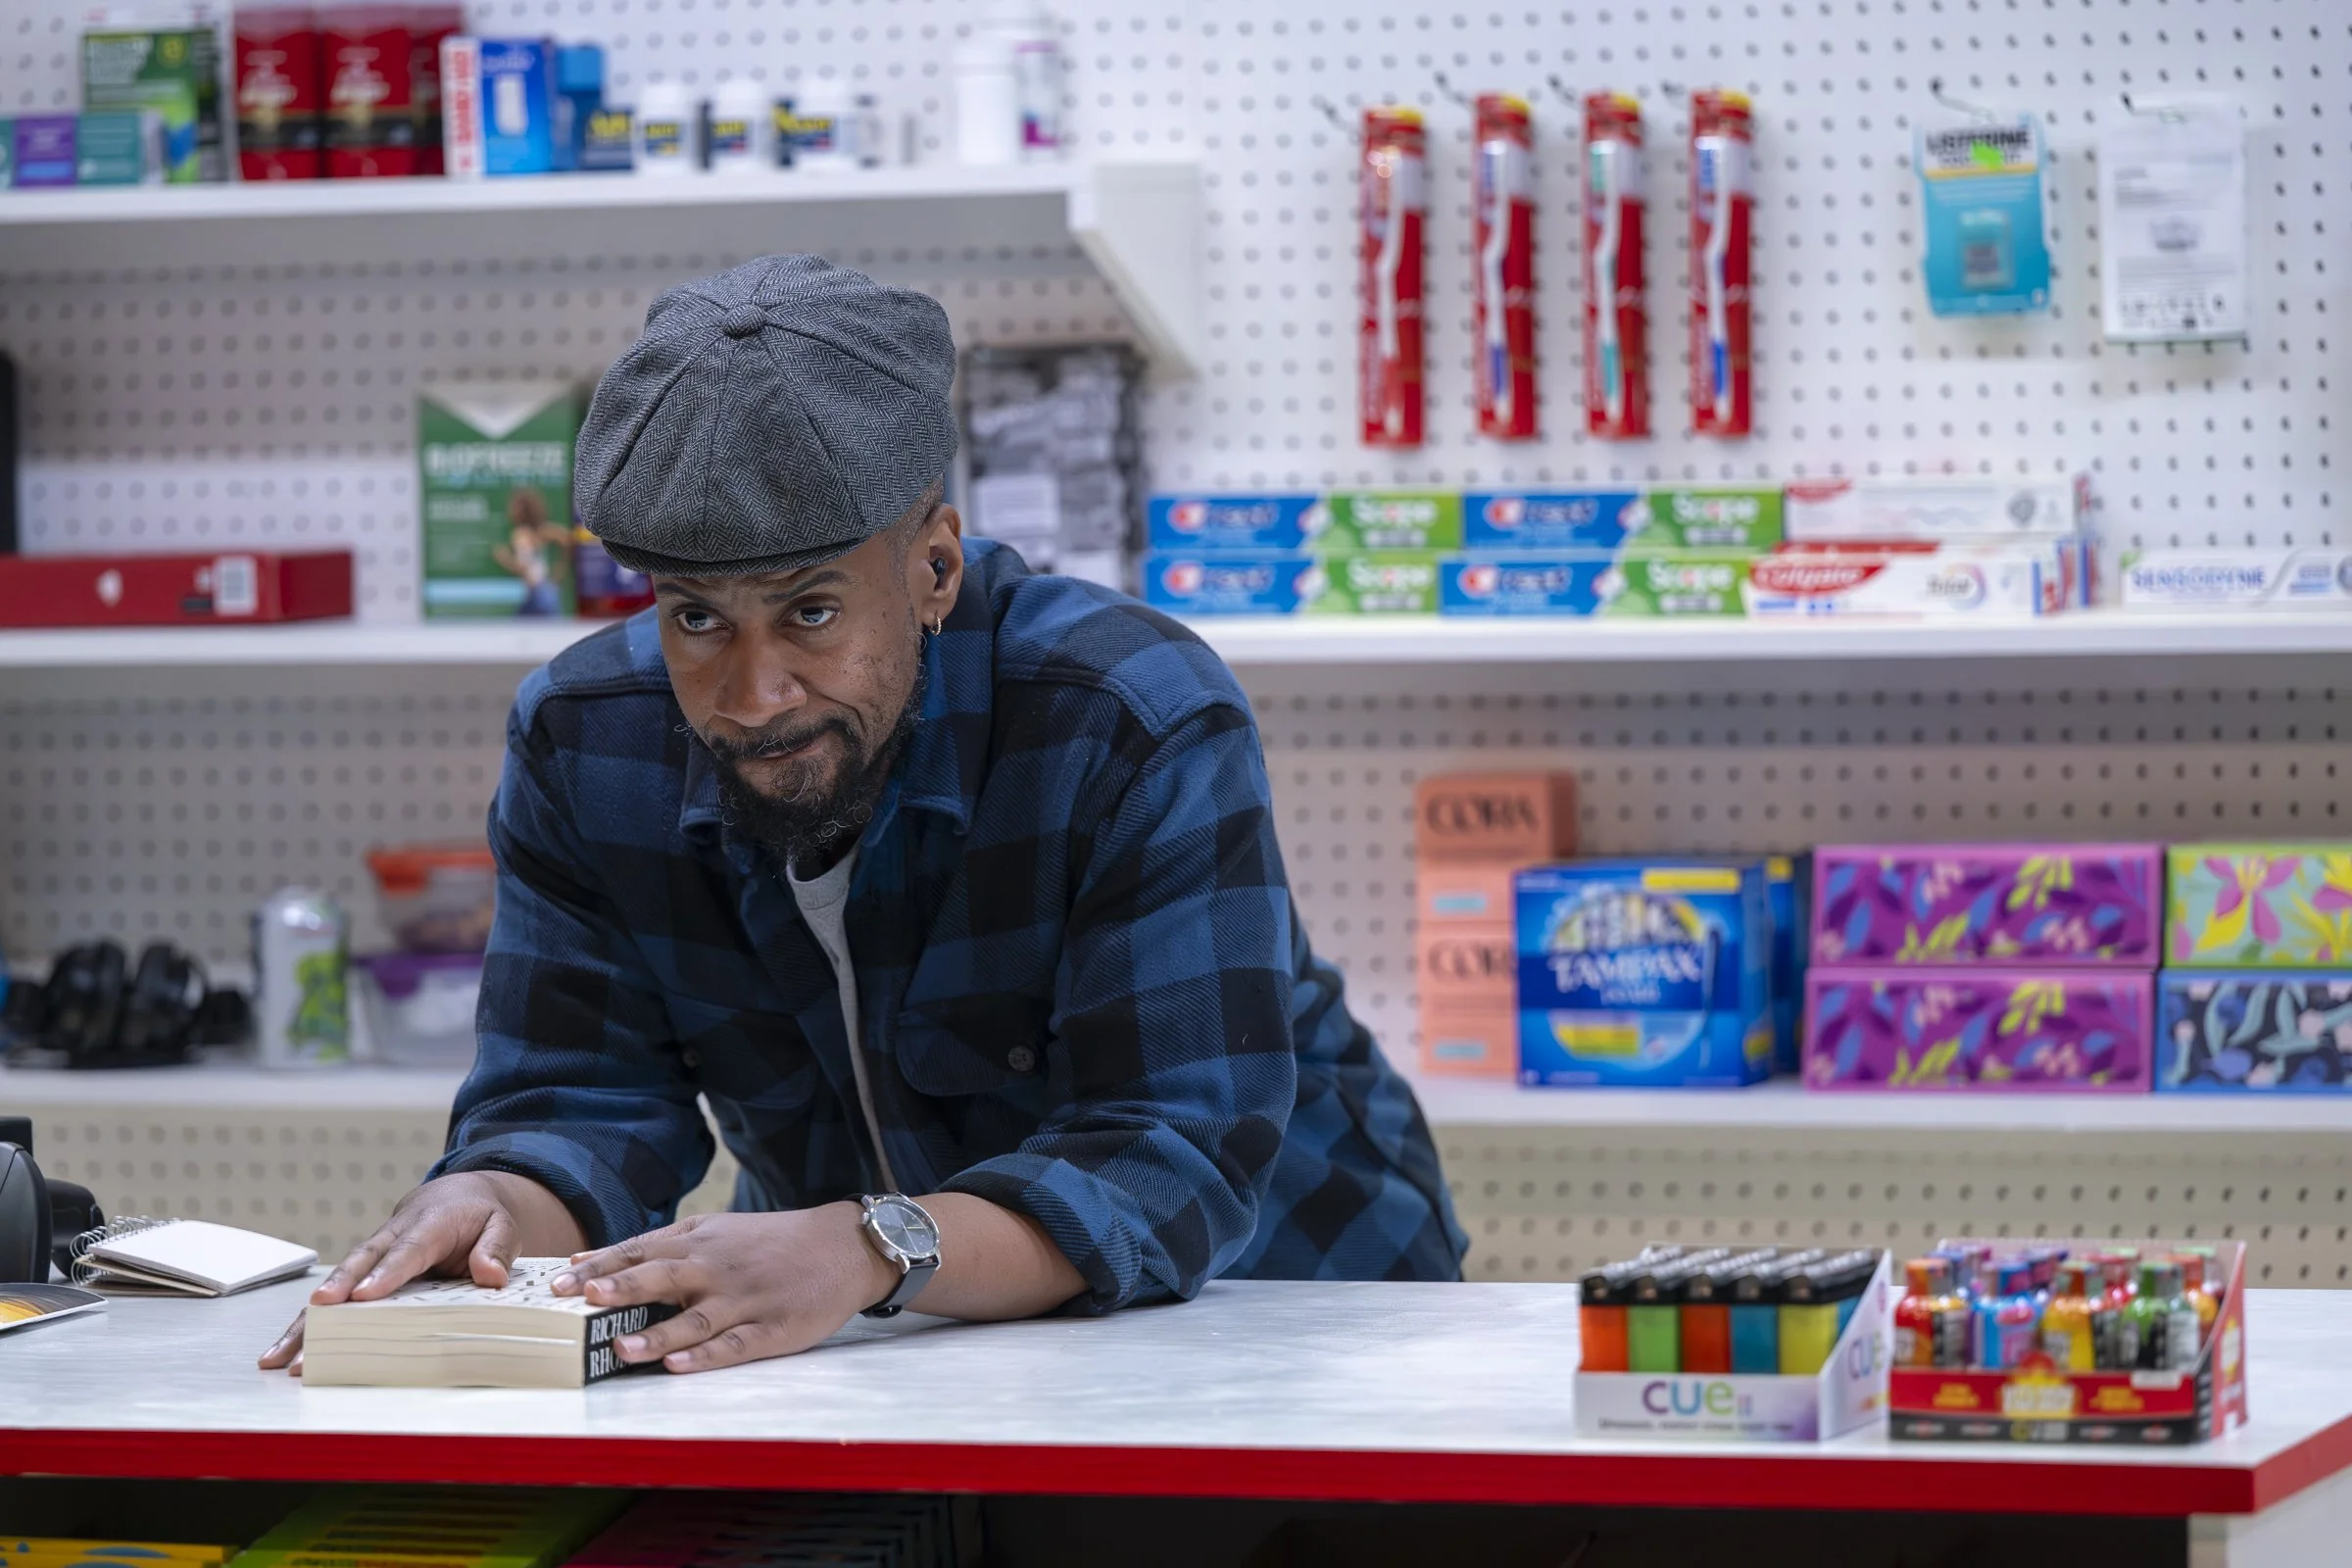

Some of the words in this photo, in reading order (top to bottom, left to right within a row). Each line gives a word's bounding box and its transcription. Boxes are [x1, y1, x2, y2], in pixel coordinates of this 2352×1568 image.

[1428, 938, 1516, 982] COR
[1546, 945, 1703, 993] TAMPAX
[590, 1306, 648, 1345] RICHARD
[589, 1347, 627, 1378] RHO
[1642, 1380, 1735, 1415] cue
